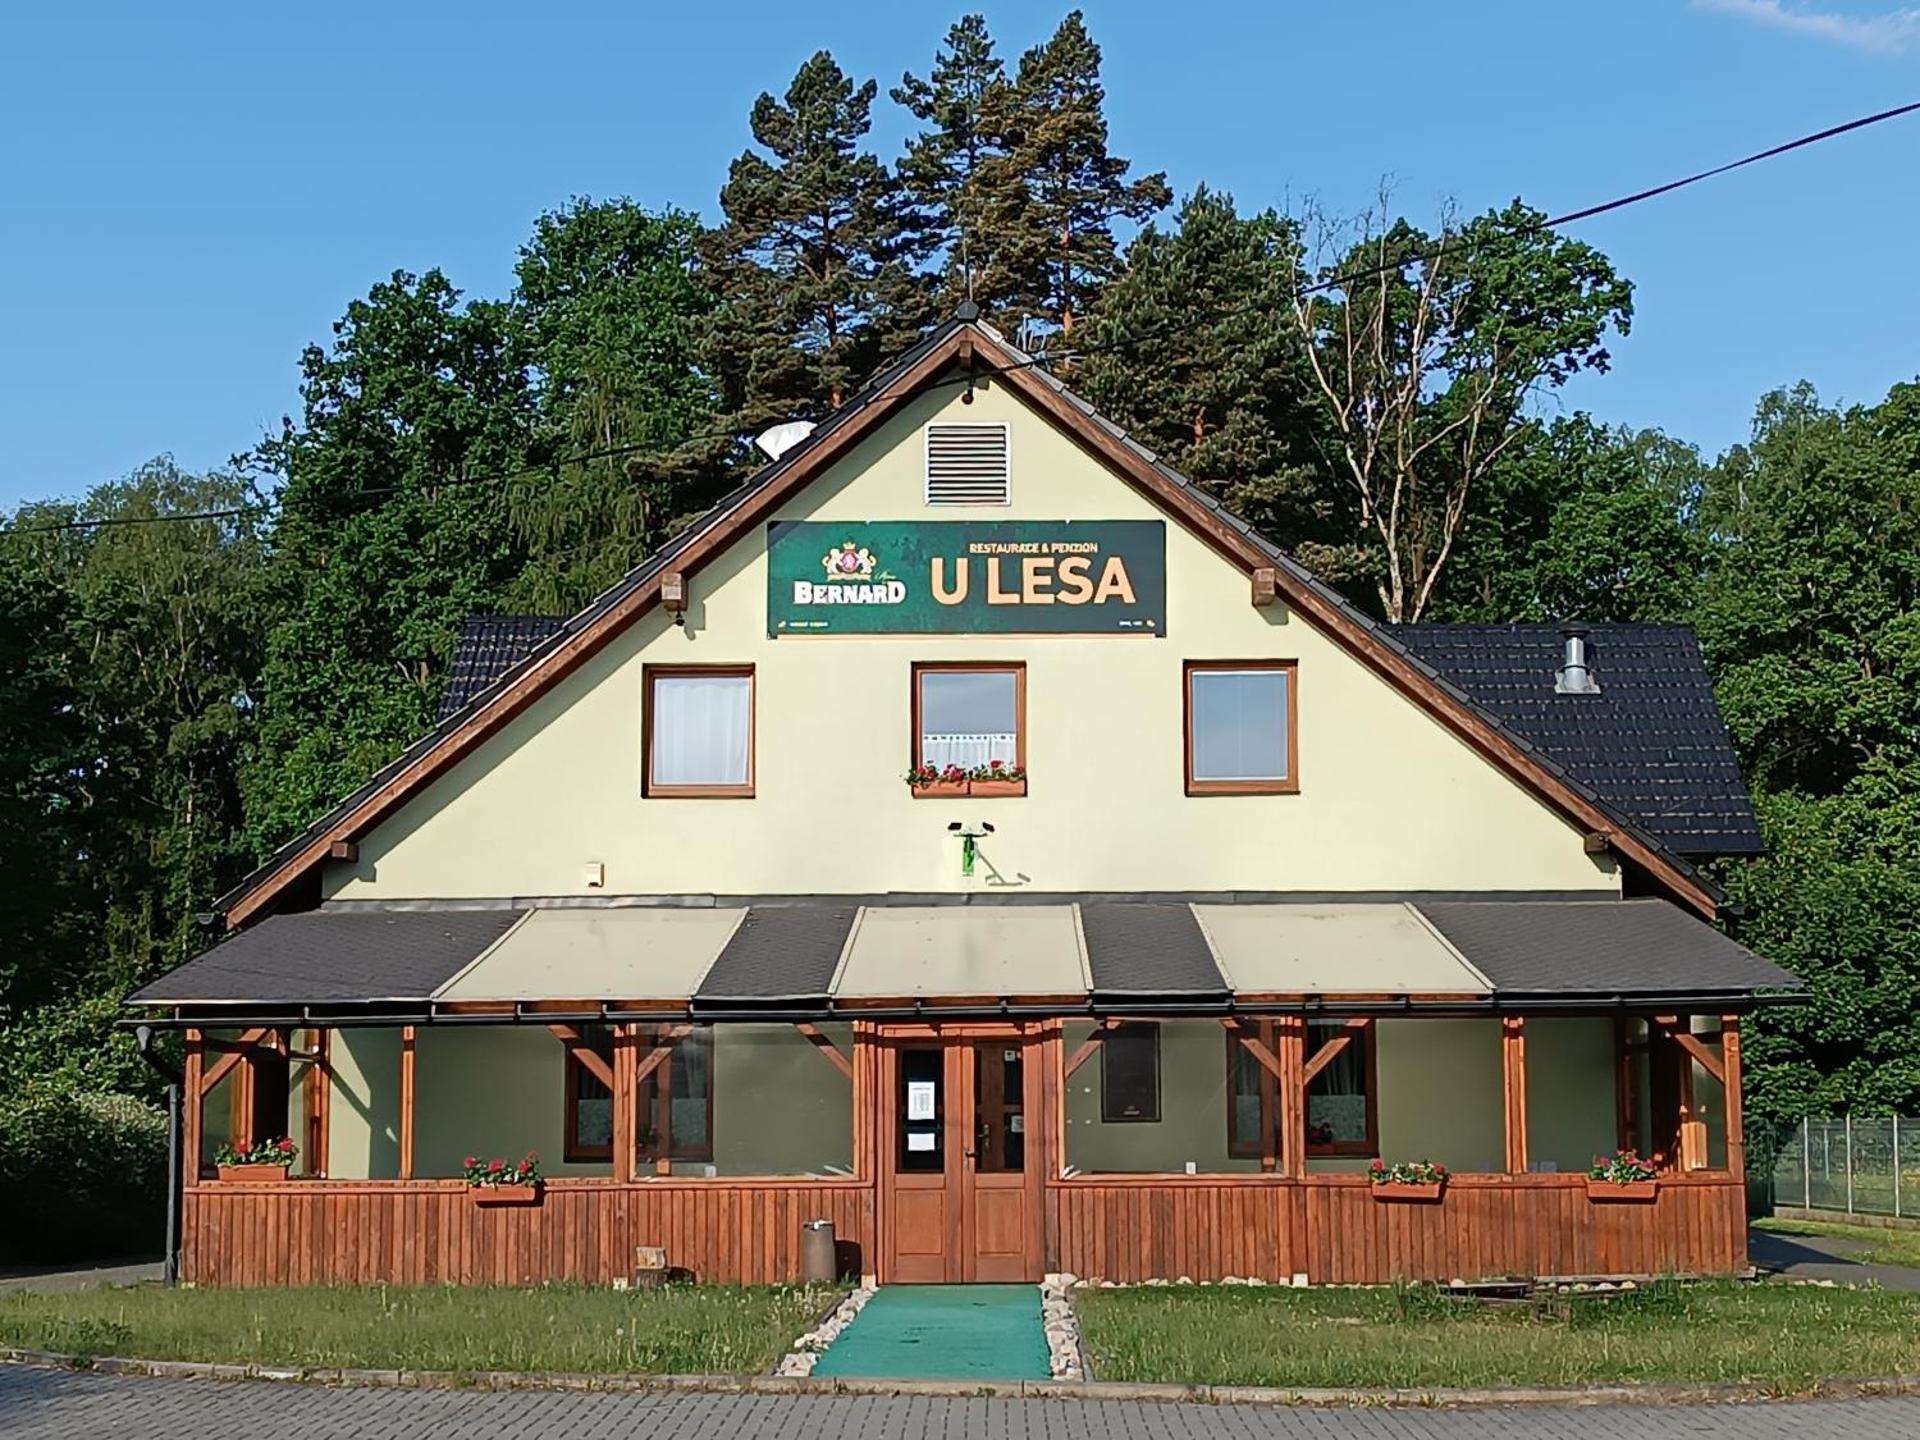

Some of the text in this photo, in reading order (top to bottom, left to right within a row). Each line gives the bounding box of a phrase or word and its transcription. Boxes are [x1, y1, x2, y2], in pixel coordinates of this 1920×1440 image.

[969, 543, 1039, 553] RESTAURACE
[931, 556, 1136, 605] U LESA
[793, 581, 906, 604] BERNARD
